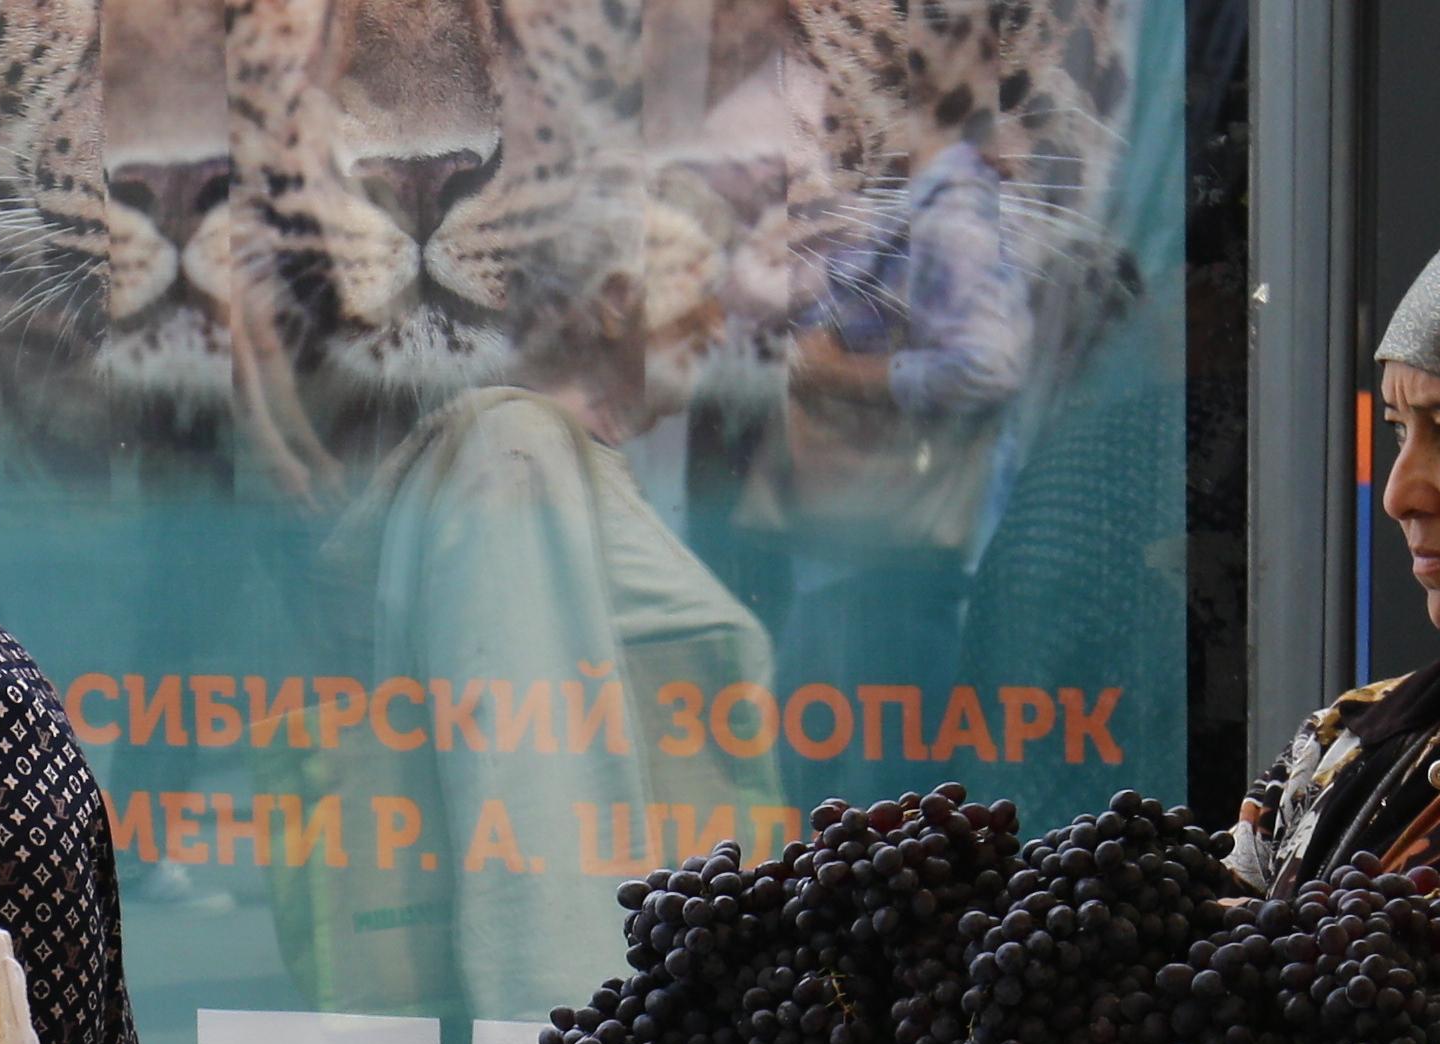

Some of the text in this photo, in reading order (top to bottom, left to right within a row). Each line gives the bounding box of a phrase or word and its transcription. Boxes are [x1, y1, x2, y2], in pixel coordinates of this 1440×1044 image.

[62, 660, 1124, 764] СИБИРСКИЙ ЗООПАРК
[100, 791, 820, 877] МЕНИ Р. А. ШИЛ
